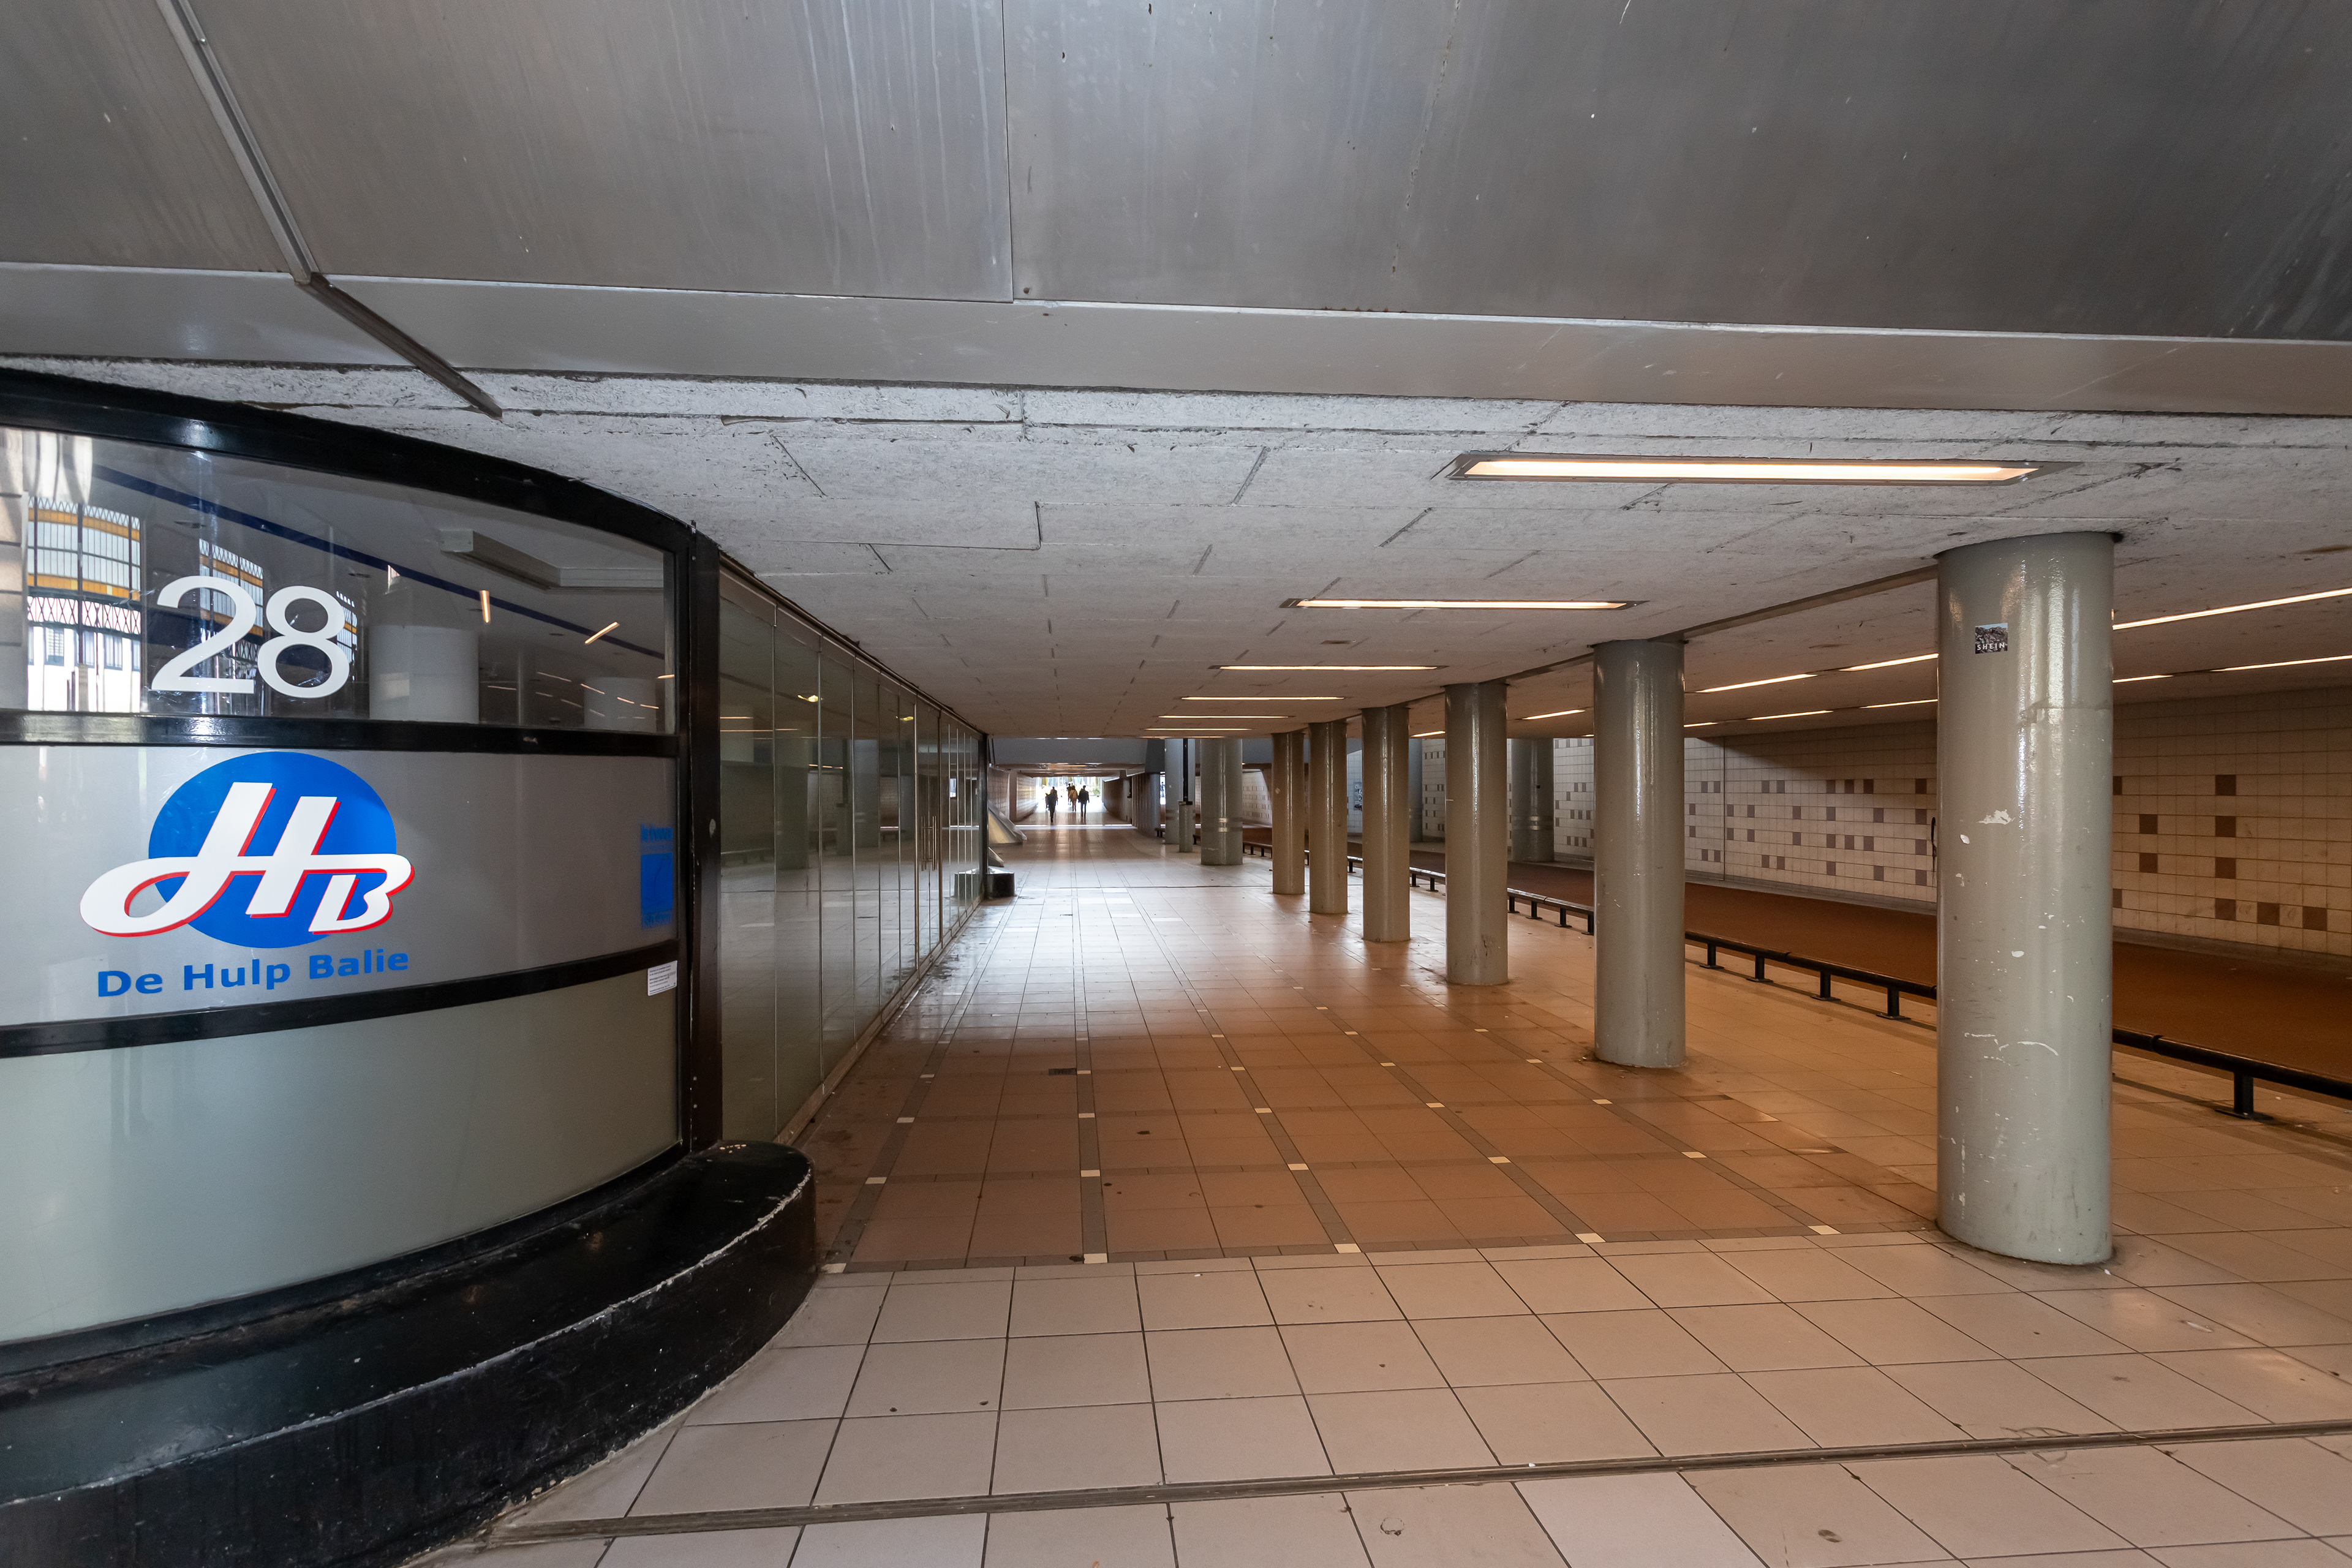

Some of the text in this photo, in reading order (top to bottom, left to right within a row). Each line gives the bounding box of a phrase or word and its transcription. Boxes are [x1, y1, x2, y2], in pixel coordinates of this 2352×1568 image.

[151, 575, 350, 698] 28
[1977, 642, 2005, 650] SHEIN
[97, 948, 409, 997] De Hulp Balie
